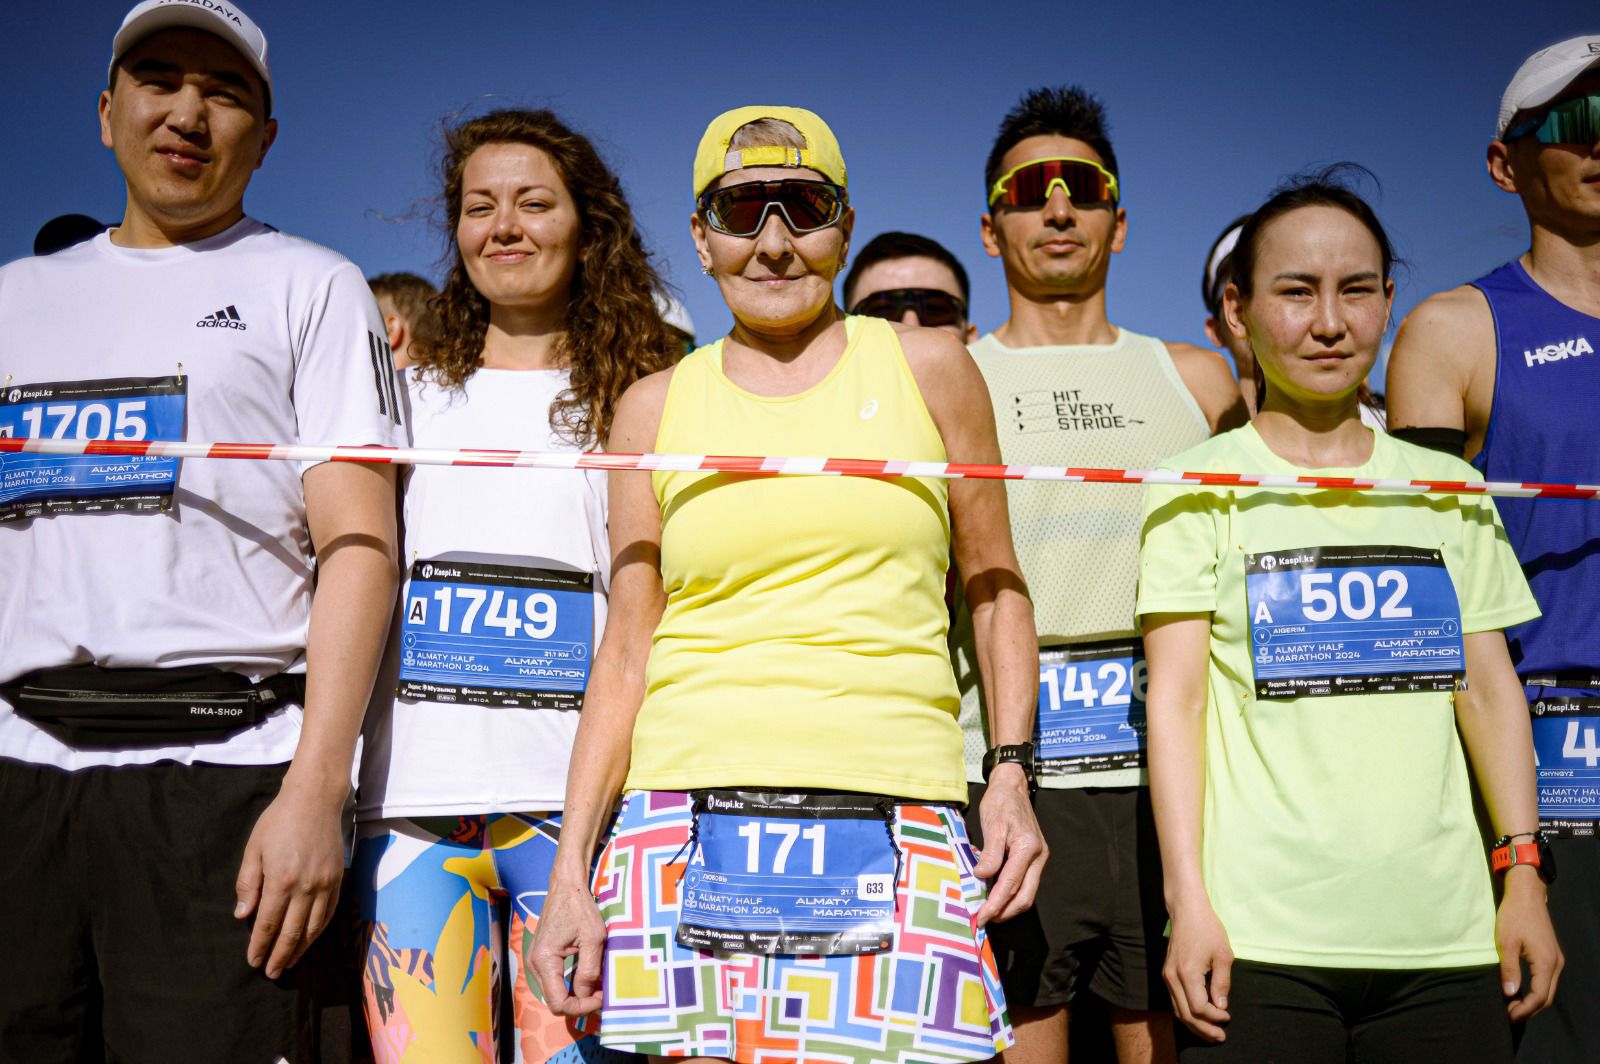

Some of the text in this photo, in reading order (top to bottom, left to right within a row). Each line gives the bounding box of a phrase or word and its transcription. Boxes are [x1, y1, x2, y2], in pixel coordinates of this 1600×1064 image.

[196, 319, 247, 331] adidas
[1524, 337, 1594, 367] HOKA
[23, 390, 53, 399] Kaspi.kz
[1053, 390, 1081, 402] HIT
[1055, 403, 1114, 417] EVERY
[22, 401, 147, 441] 1705
[1058, 416, 1126, 430] STRIDE
[4, 468, 63, 480] ALMATY HALF
[91, 464, 140, 473] ALMATY
[4, 477, 49, 488] MARATHON
[105, 472, 173, 482] MARATHON
[1278, 555, 1315, 566] Kaspi.kz
[433, 567, 462, 578] Kaspi.kz
[1301, 569, 1413, 622] 502
[410, 600, 424, 622] A
[434, 586, 557, 639] 1749
[1254, 602, 1273, 624] A
[1275, 643, 1344, 654] ALMATY HALF
[1374, 639, 1424, 648] ALMATY
[416, 652, 475, 663] ALMATY HALF
[1275, 651, 1361, 663] MARATHON 2024
[1391, 648, 1460, 658] MARATHON
[416, 659, 490, 673] MARATHON 2024
[504, 657, 553, 666] ALMATY
[519, 667, 585, 678] MARATHON
[190, 706, 243, 716] RIKA-SHOP
[1547, 703, 1580, 712] Kaspi.kz
[1040, 727, 1092, 738] MATY HALF
[1083, 734, 1107, 742] 2024
[1562, 721, 1600, 766] 4
[1541, 788, 1579, 796] ALMATY
[715, 798, 744, 809] Kaspi.kz
[738, 821, 825, 875] 171
[690, 843, 706, 867] A
[866, 882, 884, 894] G33
[698, 894, 763, 905] ALMATY HALF
[796, 898, 850, 906] ALMATY
[698, 901, 779, 915] MARATHON 2024
[813, 909, 889, 917] MARATHON
